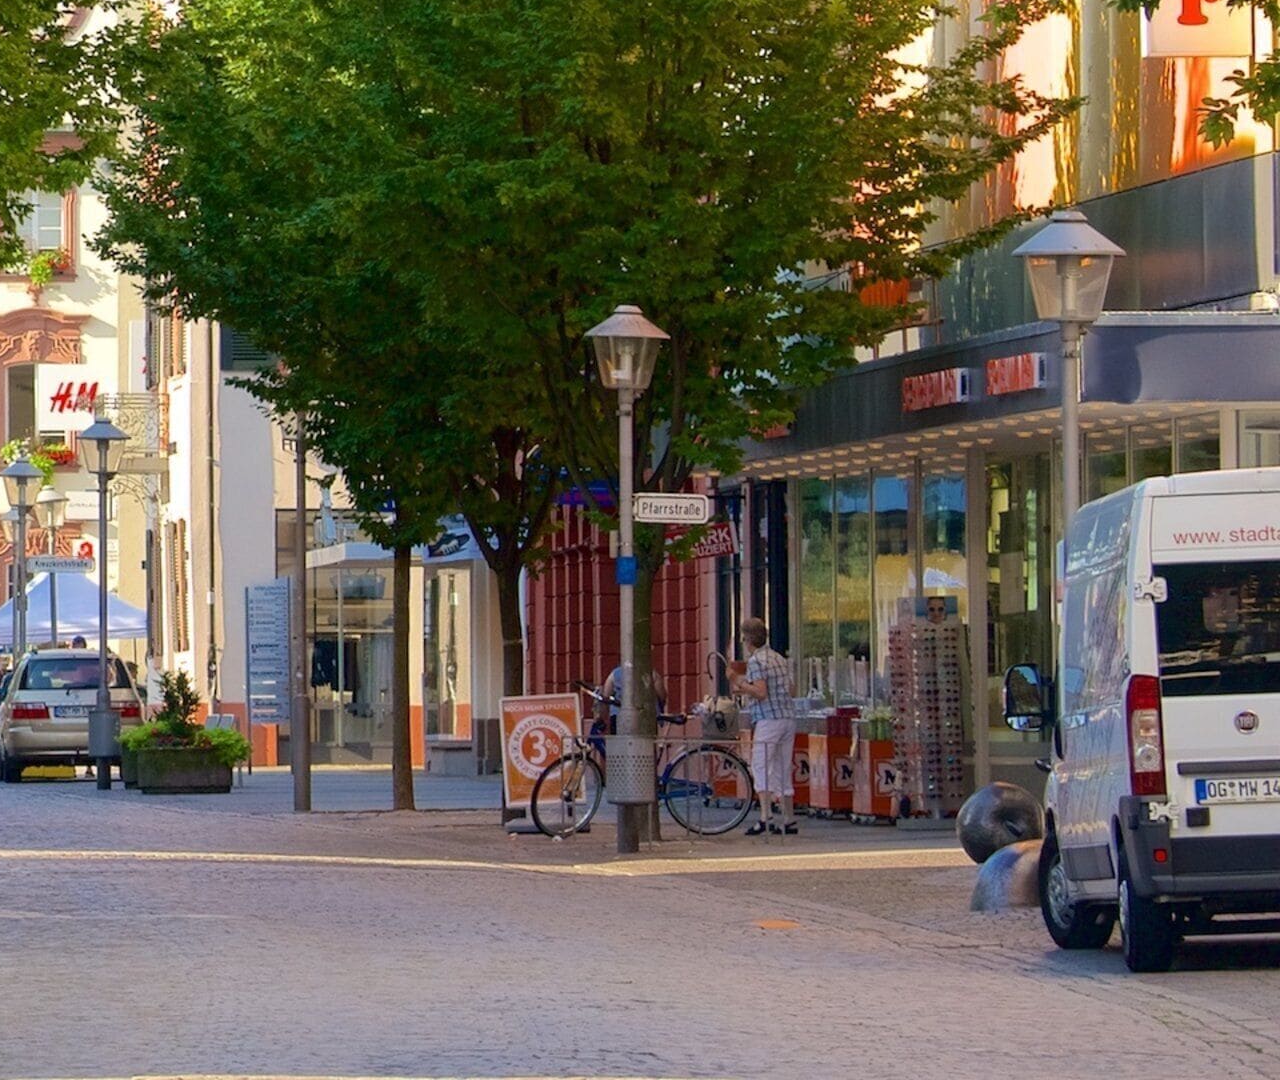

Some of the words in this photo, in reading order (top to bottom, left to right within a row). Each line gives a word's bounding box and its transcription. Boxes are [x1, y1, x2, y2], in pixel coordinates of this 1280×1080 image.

[641, 502, 701, 516] Pfarrstraße
[1207, 782, 1228, 798] OG
[1238, 781, 1258, 796] MW
